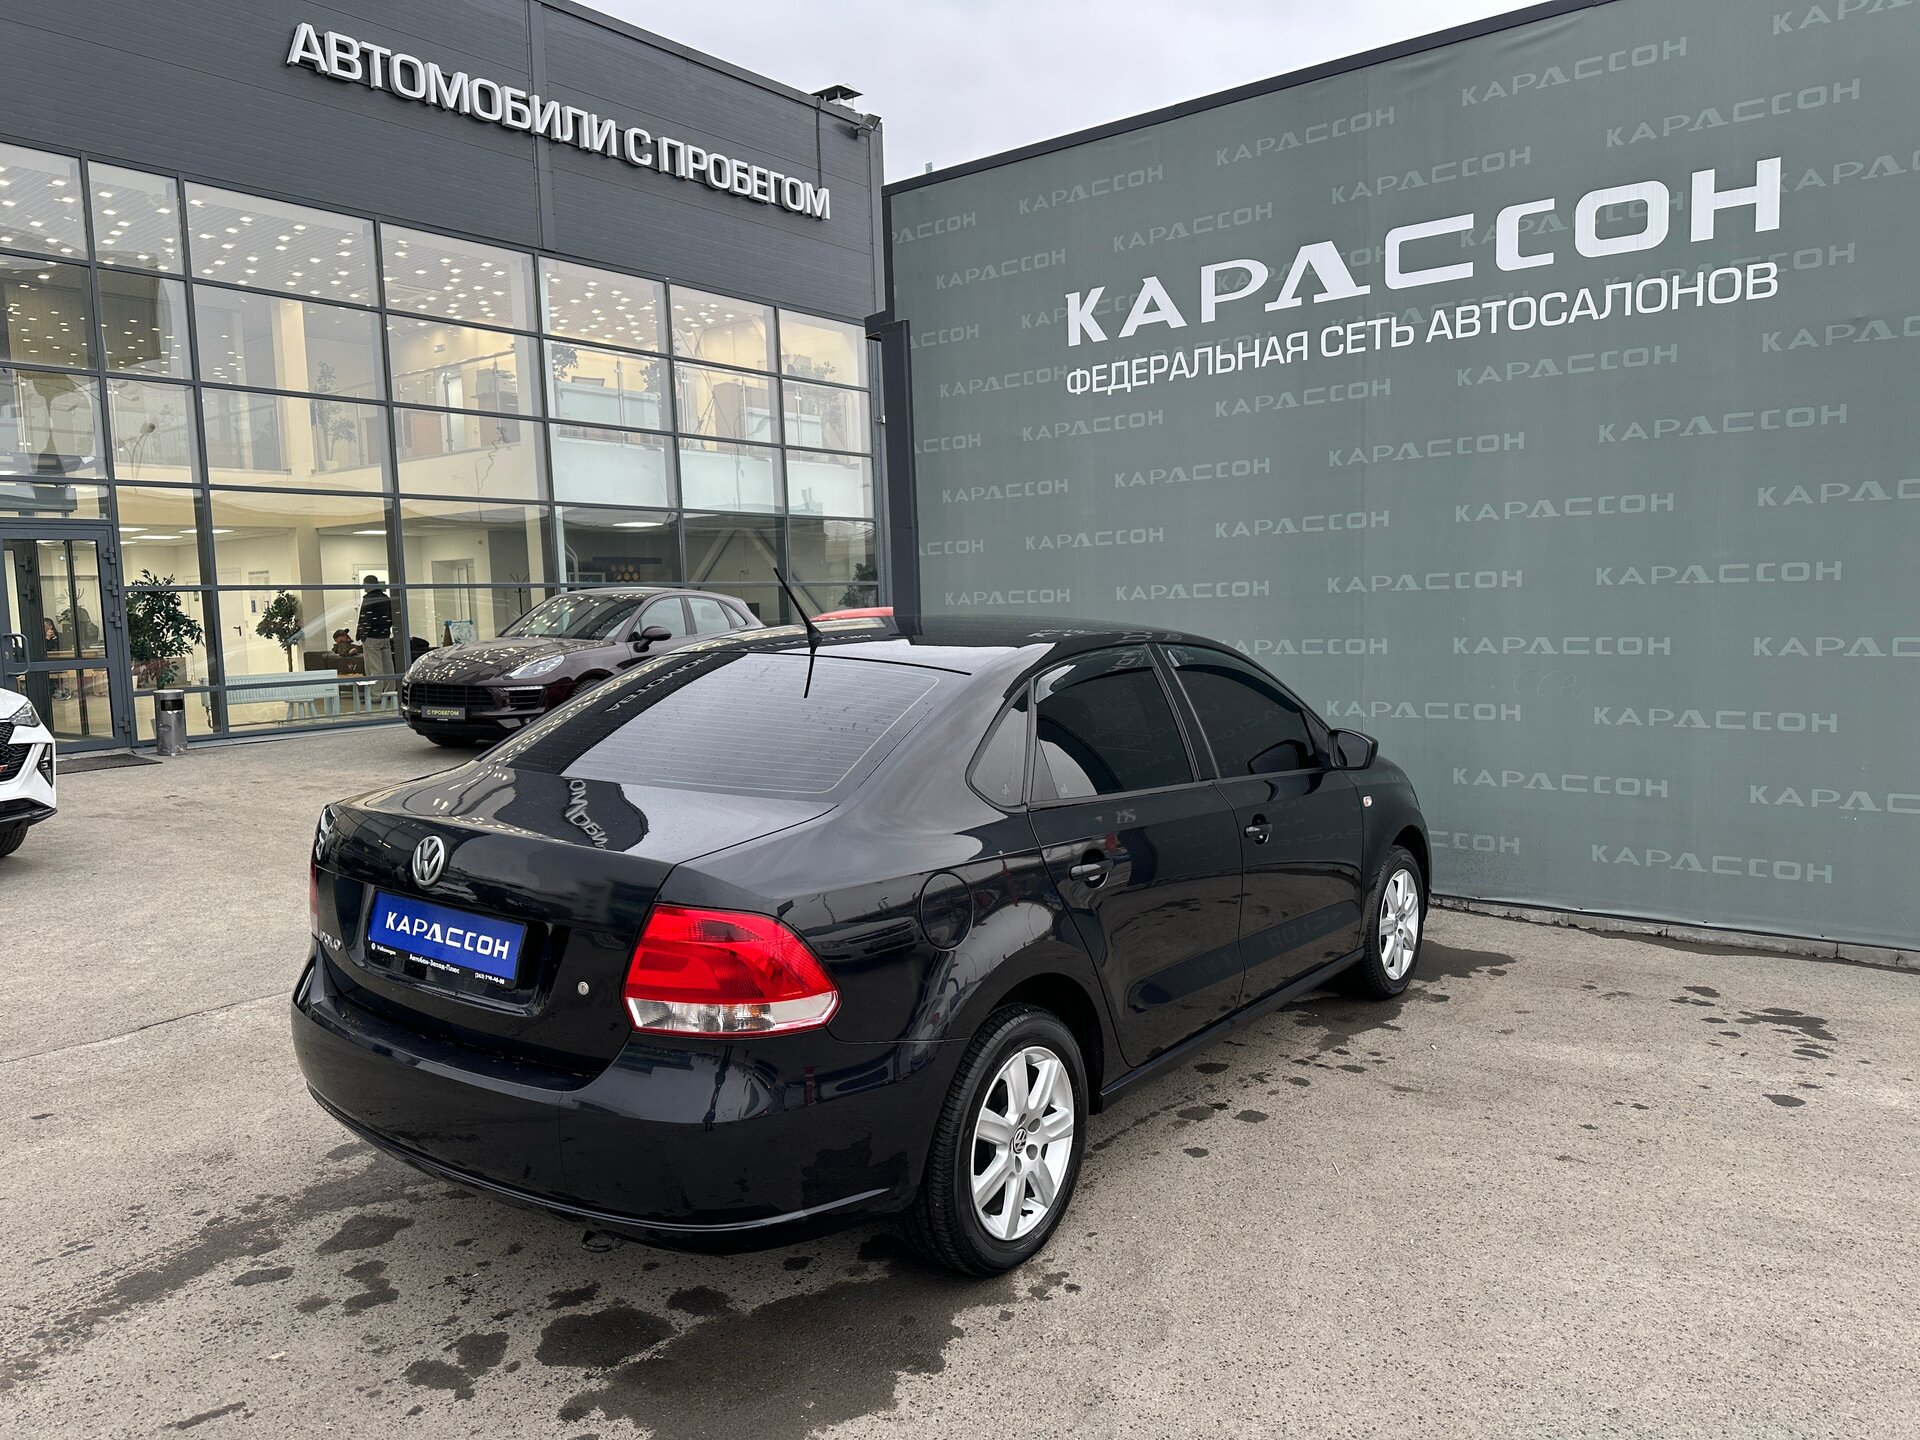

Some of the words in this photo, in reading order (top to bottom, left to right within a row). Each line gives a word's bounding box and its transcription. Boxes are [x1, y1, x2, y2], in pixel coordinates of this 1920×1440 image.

[286, 22, 617, 157] АВТОМОБИЛИ
[623, 127, 652, 167] С
[657, 136, 830, 220] ПРОБЕГОМ
[1066, 330, 1308, 396] ФЕДЕРАЛЬНАЯ
[1320, 317, 1415, 359] СЕТЬ
[1425, 262, 1780, 343] АВТОСАЛОНОВ
